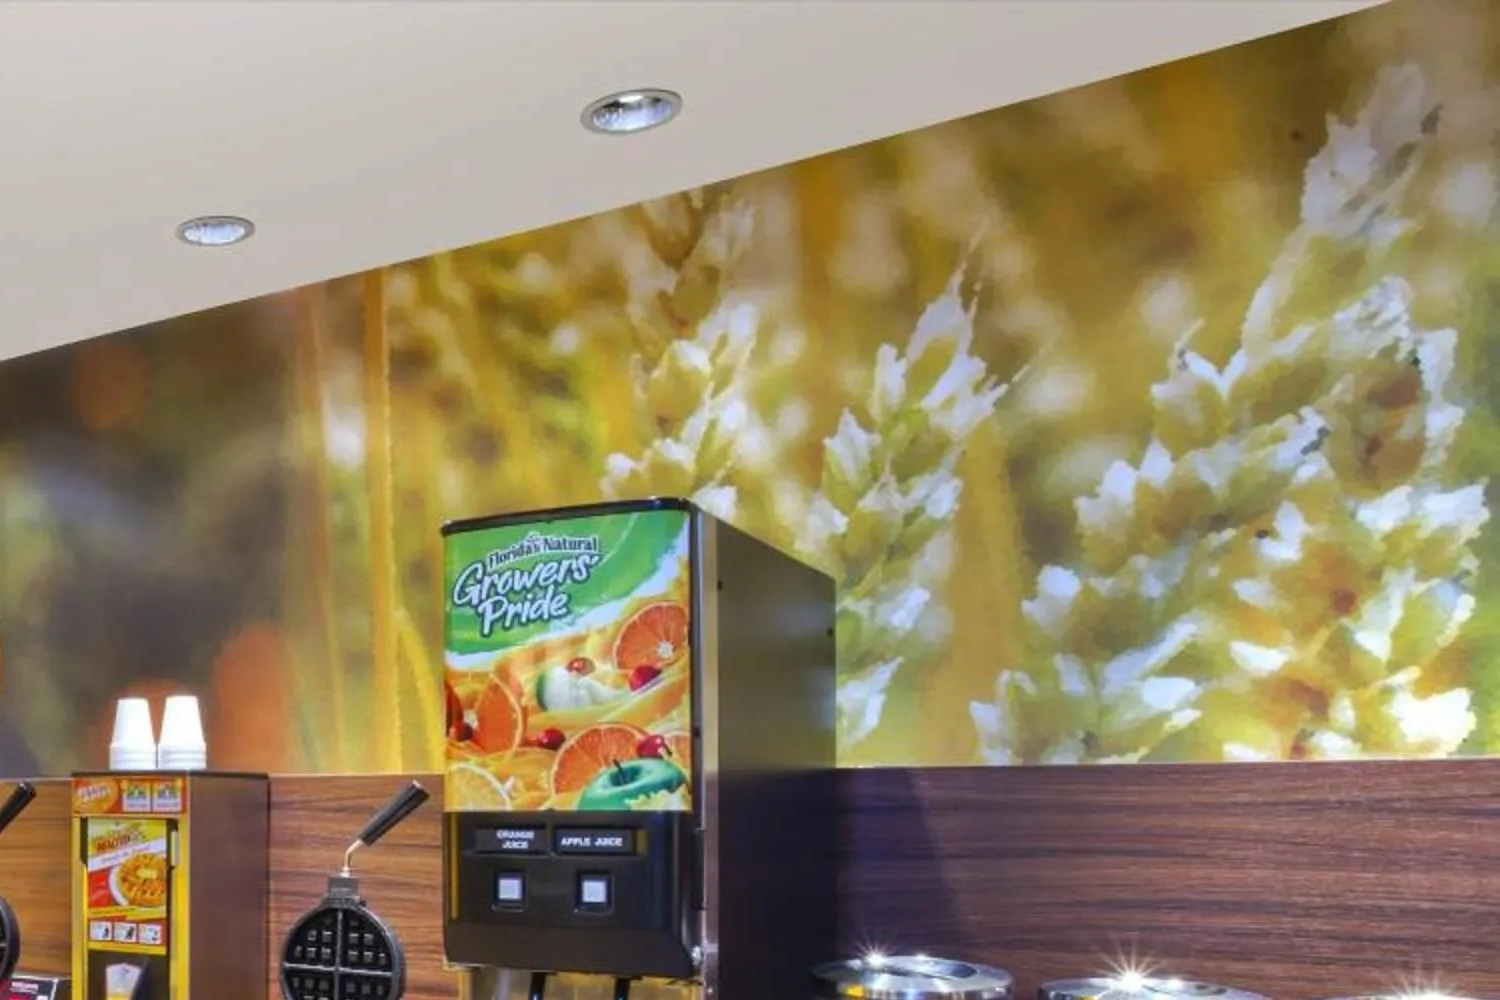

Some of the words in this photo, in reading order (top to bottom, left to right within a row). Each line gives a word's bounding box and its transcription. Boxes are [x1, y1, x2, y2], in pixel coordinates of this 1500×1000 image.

[544, 537, 597, 552] Natural
[453, 554, 600, 605] Growers'
[477, 584, 569, 635] Pride
[496, 829, 535, 840] ORANGE
[502, 840, 529, 849] JUICE
[561, 837, 591, 847] APPLE
[594, 837, 623, 847] JUICE
